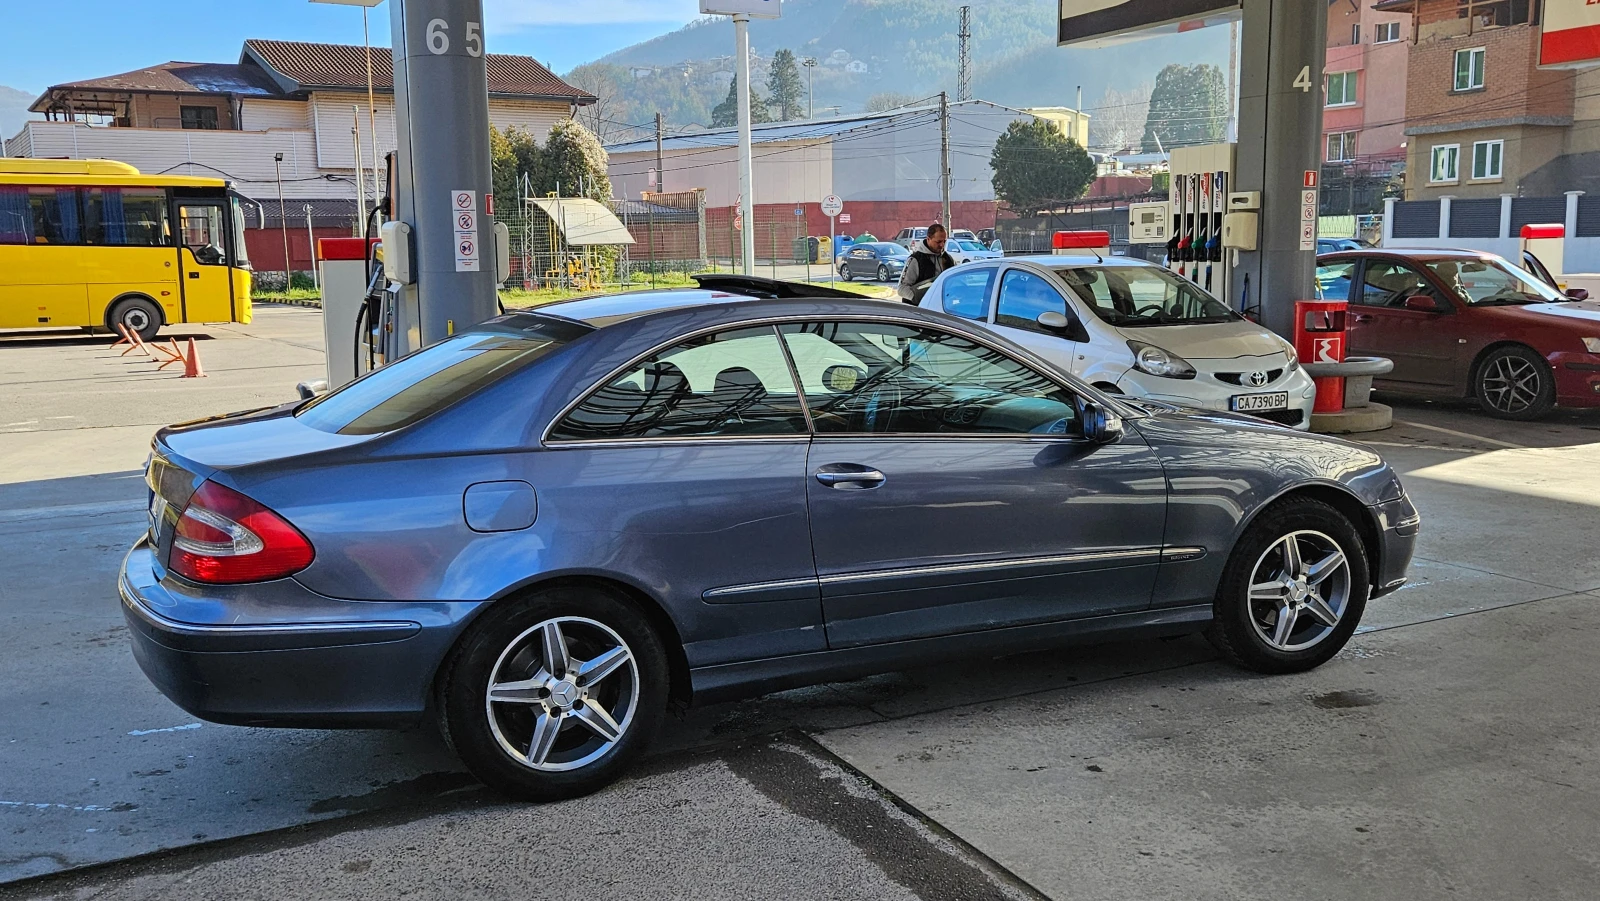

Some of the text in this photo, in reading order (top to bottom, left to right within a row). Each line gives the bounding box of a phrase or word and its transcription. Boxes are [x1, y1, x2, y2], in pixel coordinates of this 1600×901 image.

[426, 18, 482, 58] 6 5
[1292, 65, 1312, 93] 4
